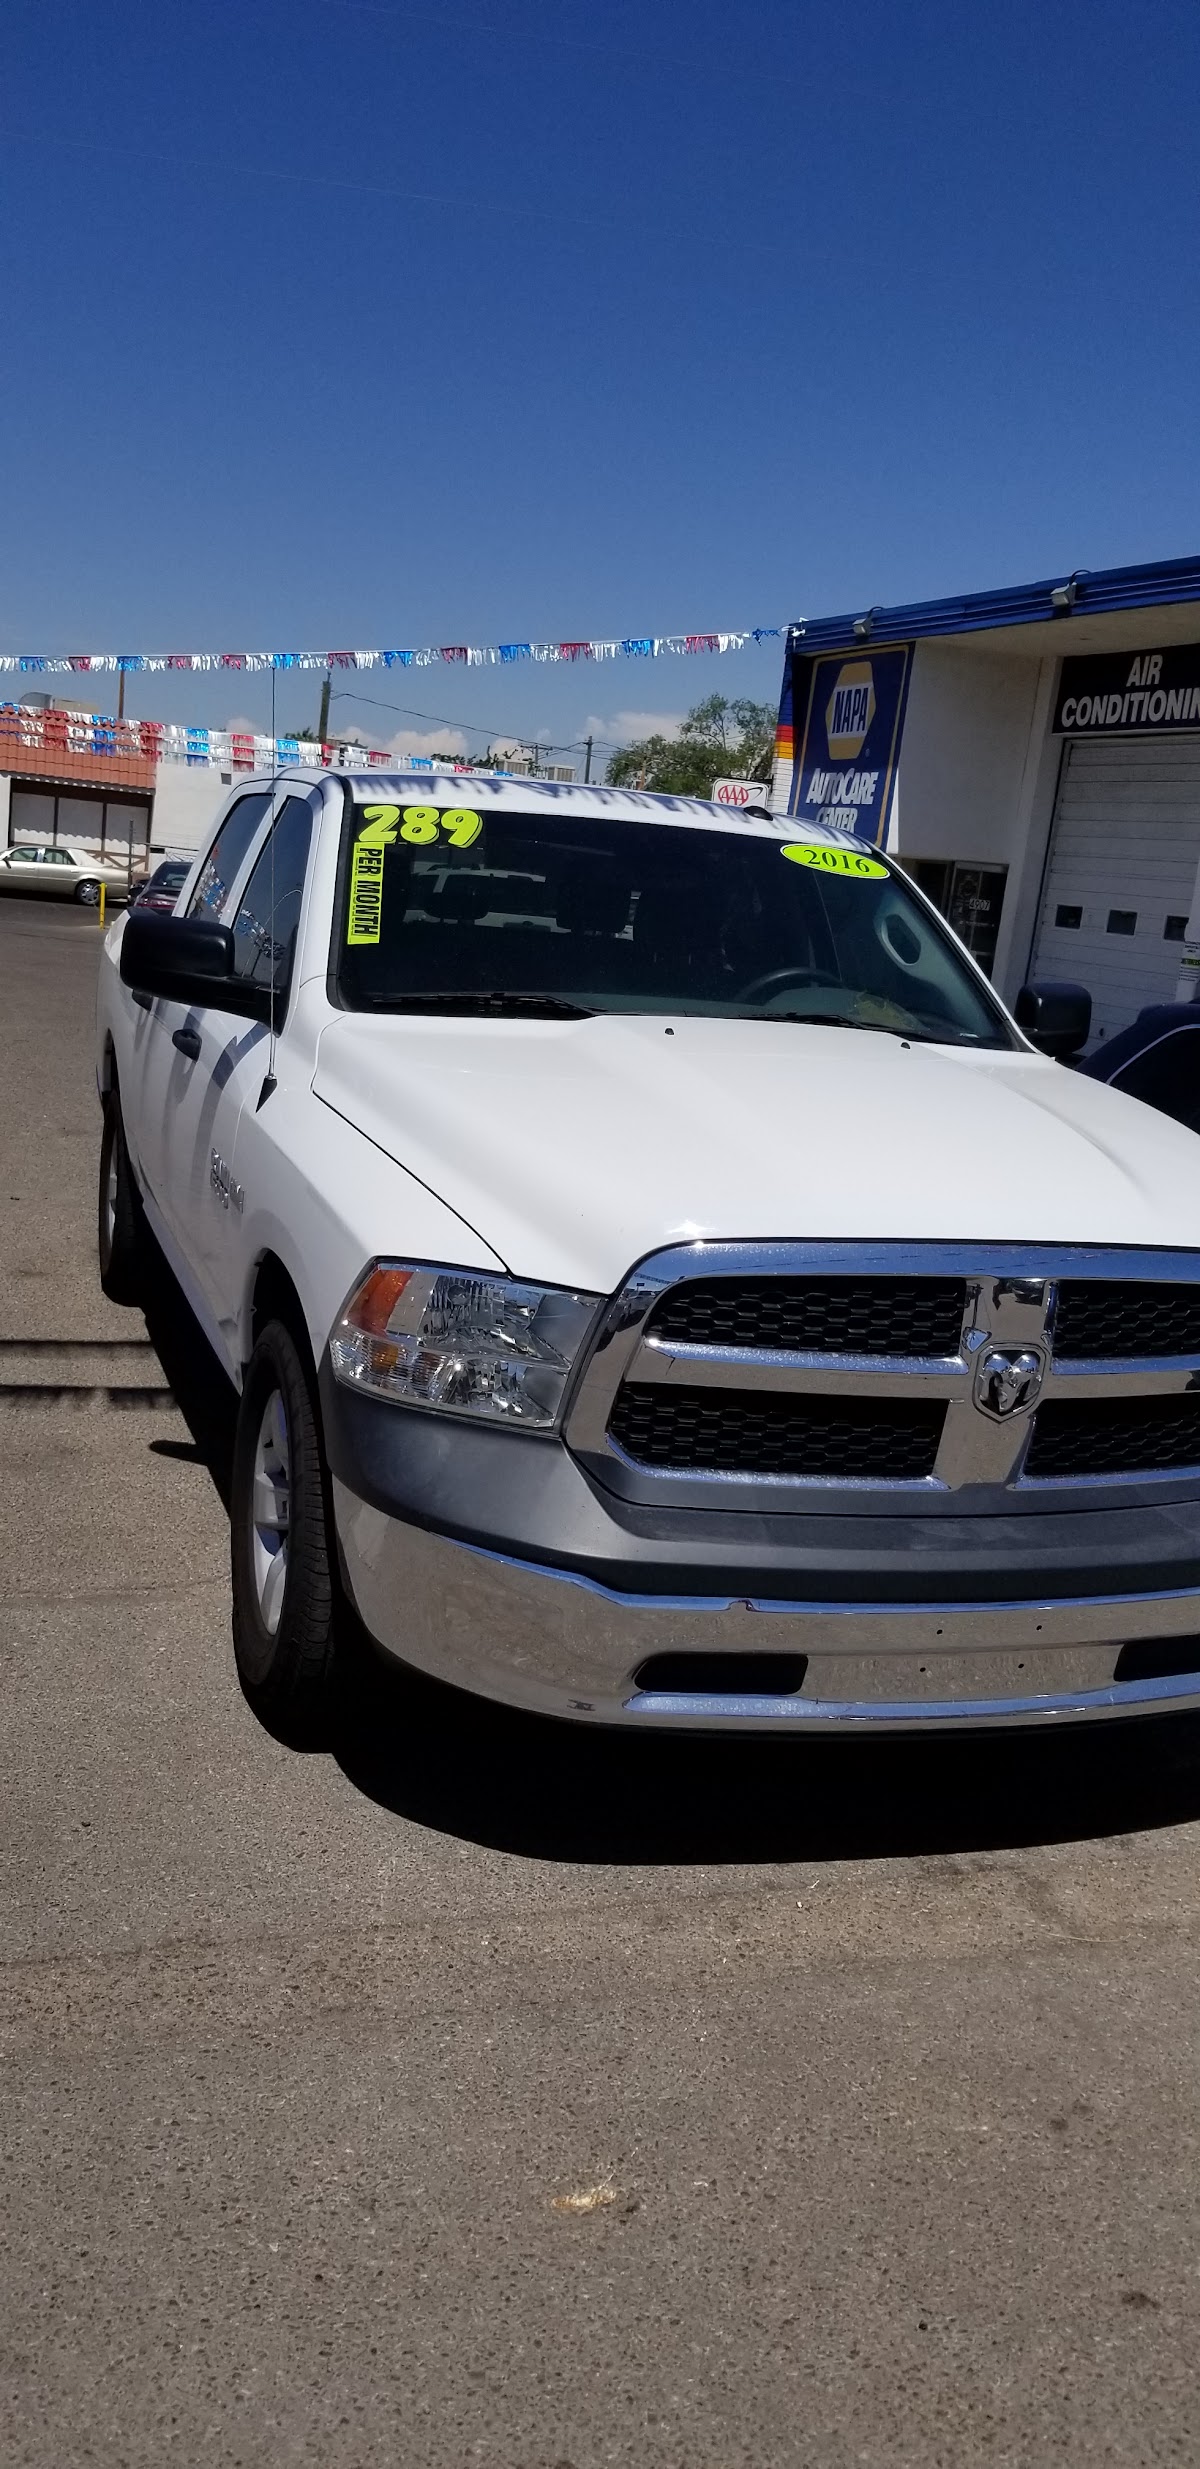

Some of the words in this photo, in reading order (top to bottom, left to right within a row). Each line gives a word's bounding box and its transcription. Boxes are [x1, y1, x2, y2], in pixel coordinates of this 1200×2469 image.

[1125, 654, 1164, 687] AIR
[832, 687, 869, 733] NAPA
[718, 785, 749, 806] AAA
[805, 768, 879, 805] AUTOCARE
[358, 805, 483, 848] 289
[815, 807, 858, 834] CENTER
[357, 847, 383, 876] PER
[803, 849, 870, 873] 2016
[353, 879, 381, 937] MONTH
